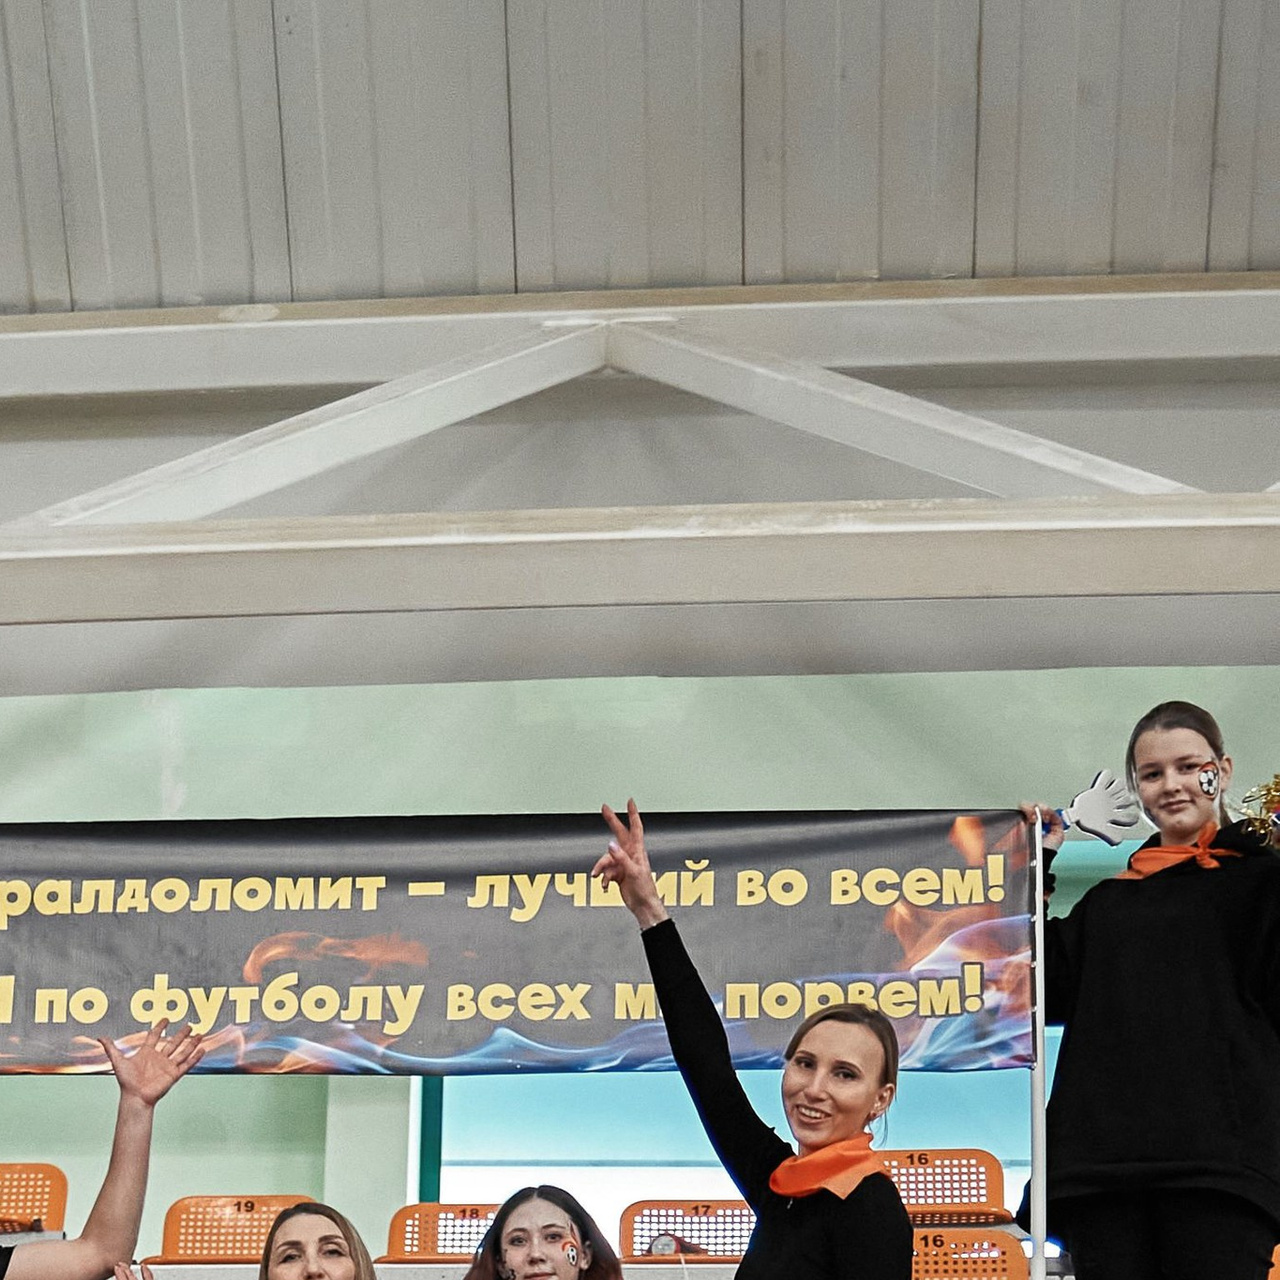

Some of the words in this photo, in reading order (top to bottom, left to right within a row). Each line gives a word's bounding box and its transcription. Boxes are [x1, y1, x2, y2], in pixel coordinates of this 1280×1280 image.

[736, 869, 809, 906] во
[830, 853, 1007, 907] всем!
[34, 988, 109, 1024] по
[129, 971, 425, 1036] футболу
[446, 983, 592, 1021] всех
[613, 982, 660, 1021] м
[724, 962, 985, 1021] порвем!
[906, 1152, 929, 1166] 16
[233, 1200, 256, 1213] 19
[690, 1204, 712, 1218] 17
[458, 1208, 481, 1221] 18
[919, 1234, 946, 1249] 16
